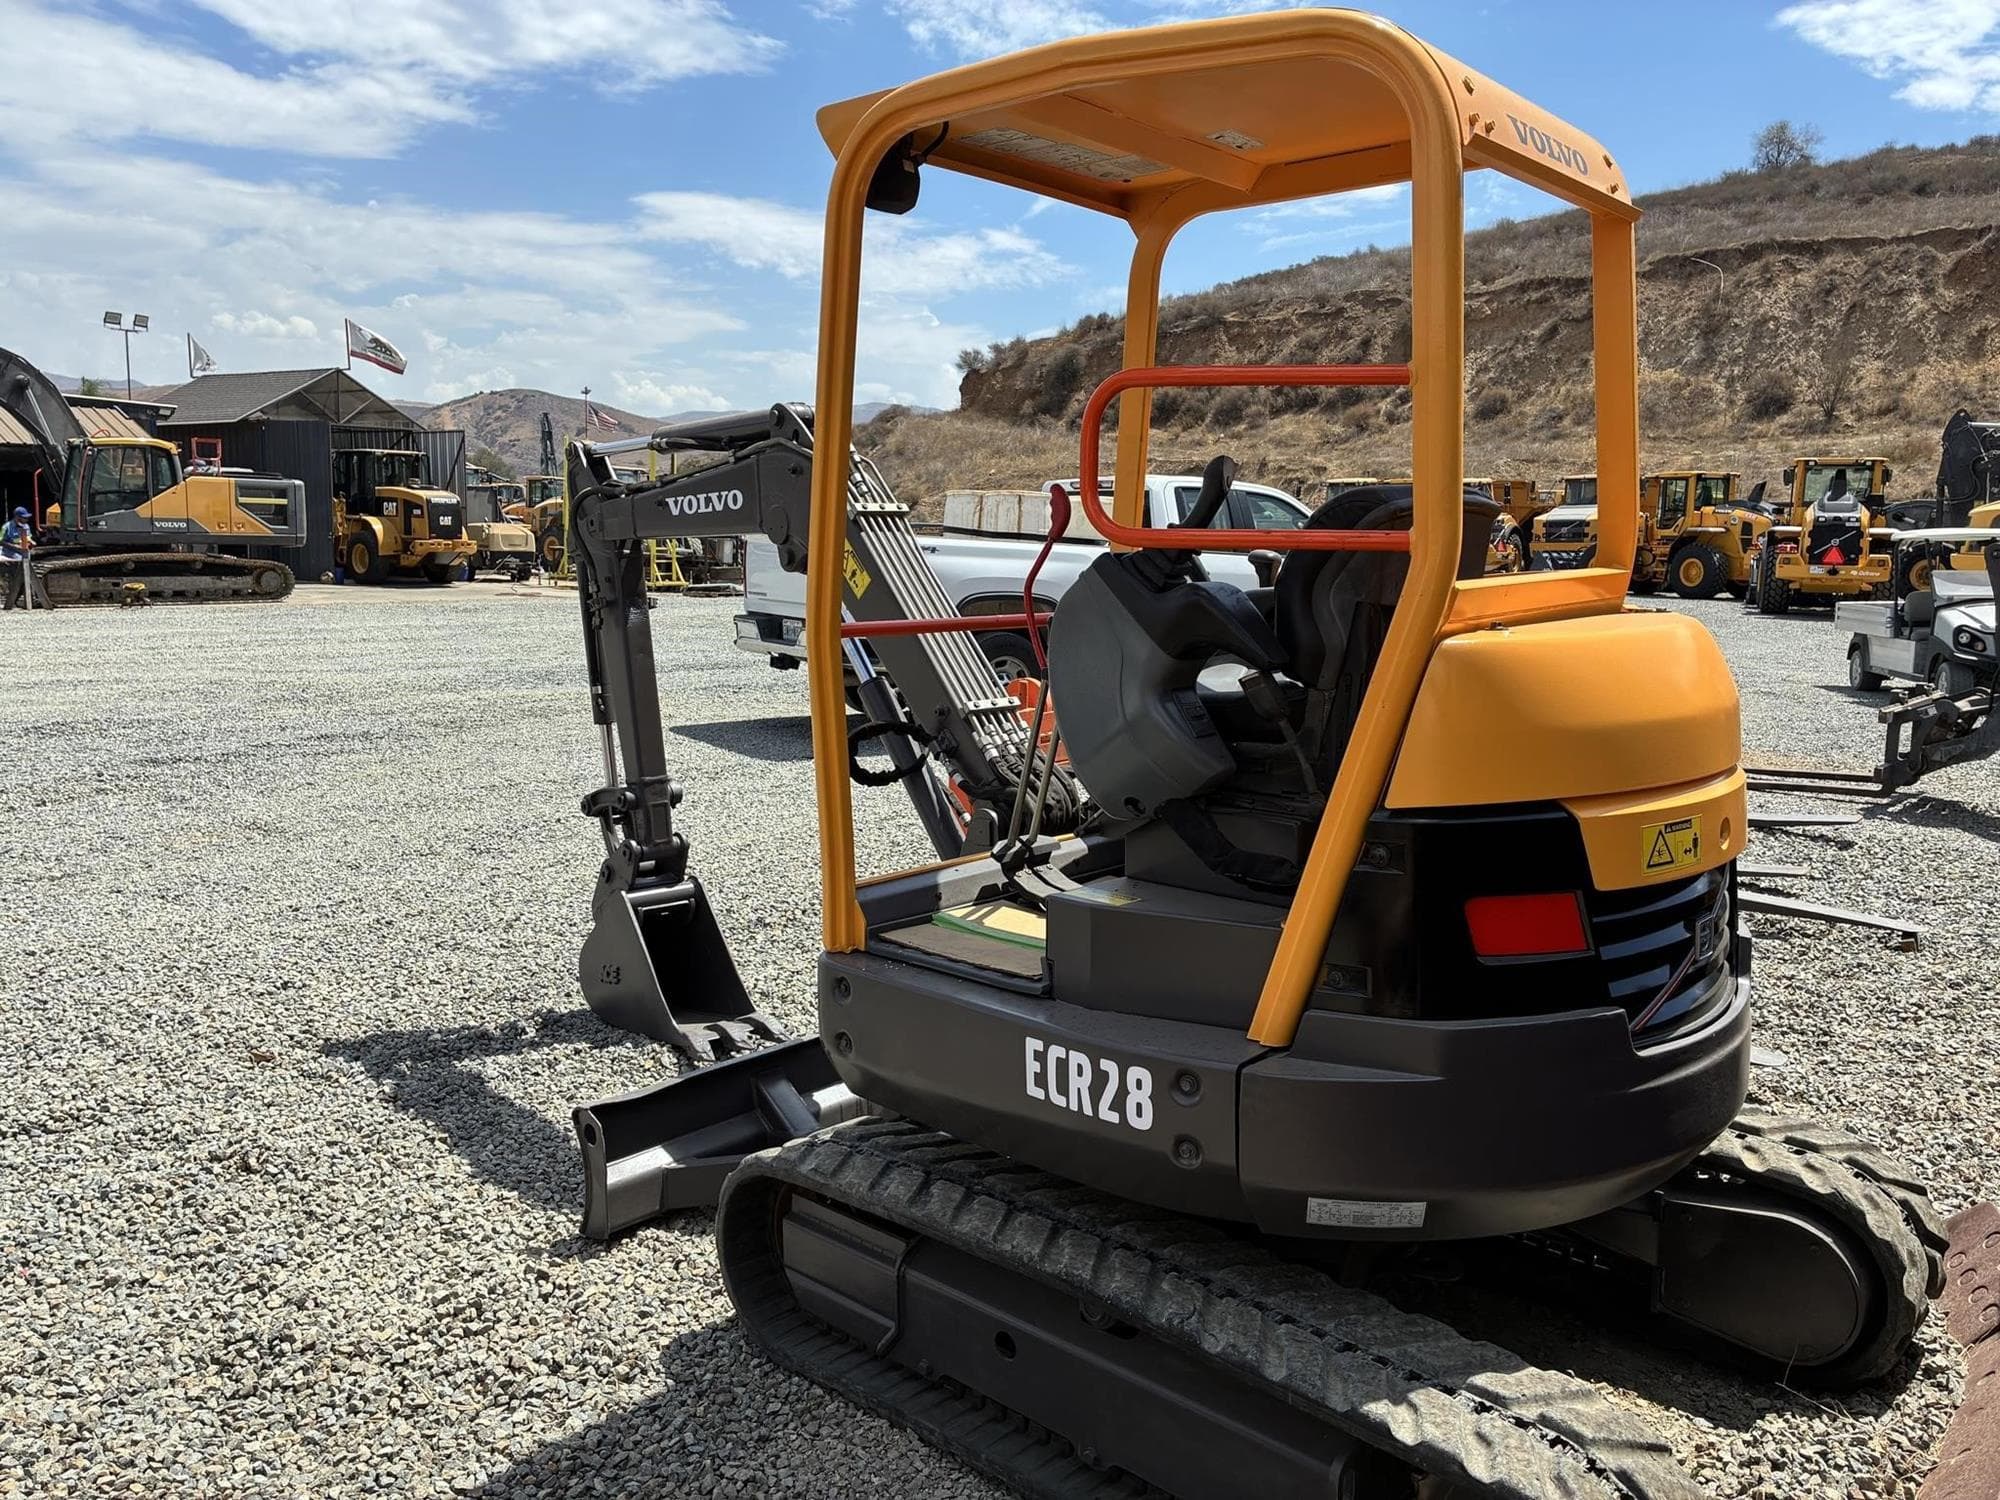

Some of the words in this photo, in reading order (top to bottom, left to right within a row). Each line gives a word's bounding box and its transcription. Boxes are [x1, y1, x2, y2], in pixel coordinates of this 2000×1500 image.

[1506, 113, 1588, 176] VOLVO
[383, 502, 397, 516] CAT
[665, 489, 743, 516] VOLVO
[439, 516, 452, 525] CAT
[1025, 1036, 1154, 1131] ECR28
